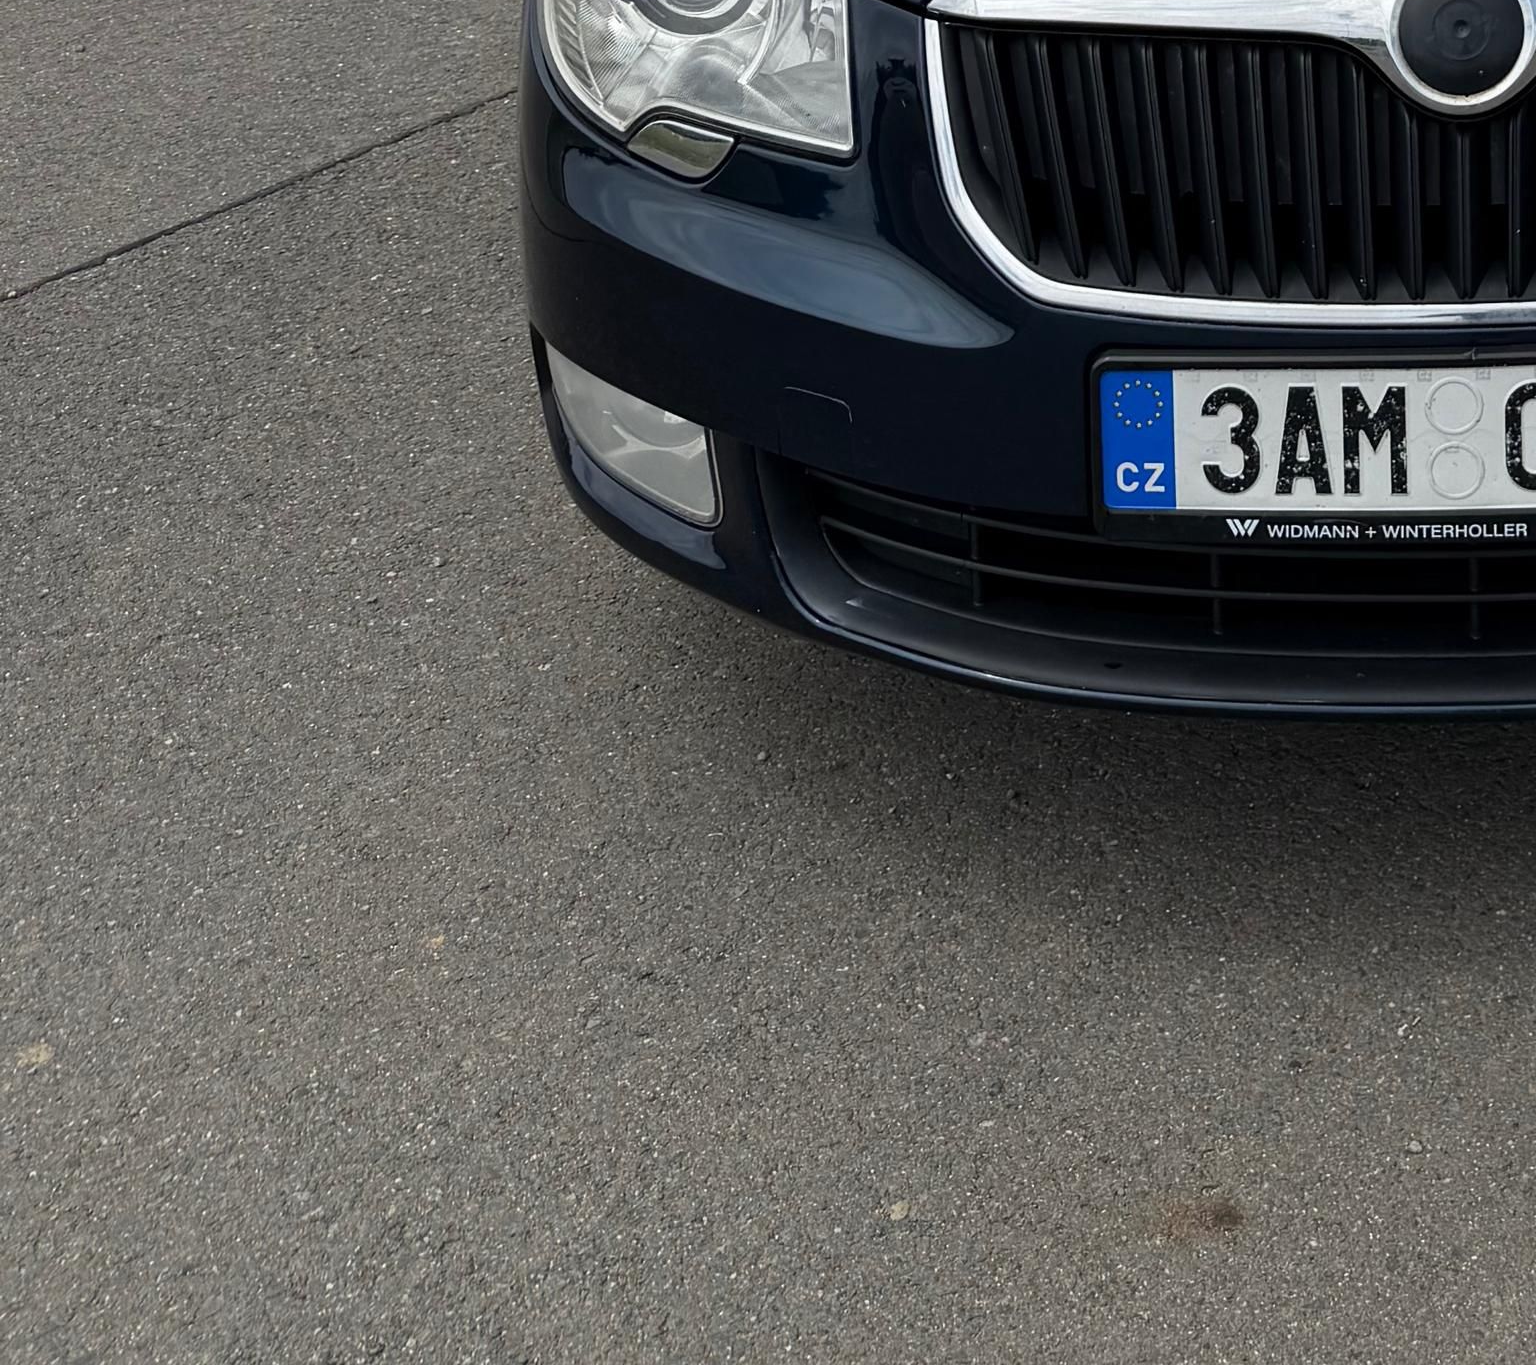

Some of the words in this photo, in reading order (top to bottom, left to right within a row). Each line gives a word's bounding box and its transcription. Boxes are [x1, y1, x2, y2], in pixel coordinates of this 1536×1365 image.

[1201, 384, 1410, 496] 3AM
[1116, 462, 1167, 492] CZ
[1267, 525, 1359, 539] WIDMANN
[1382, 523, 1528, 539] WINTERHOLLER
